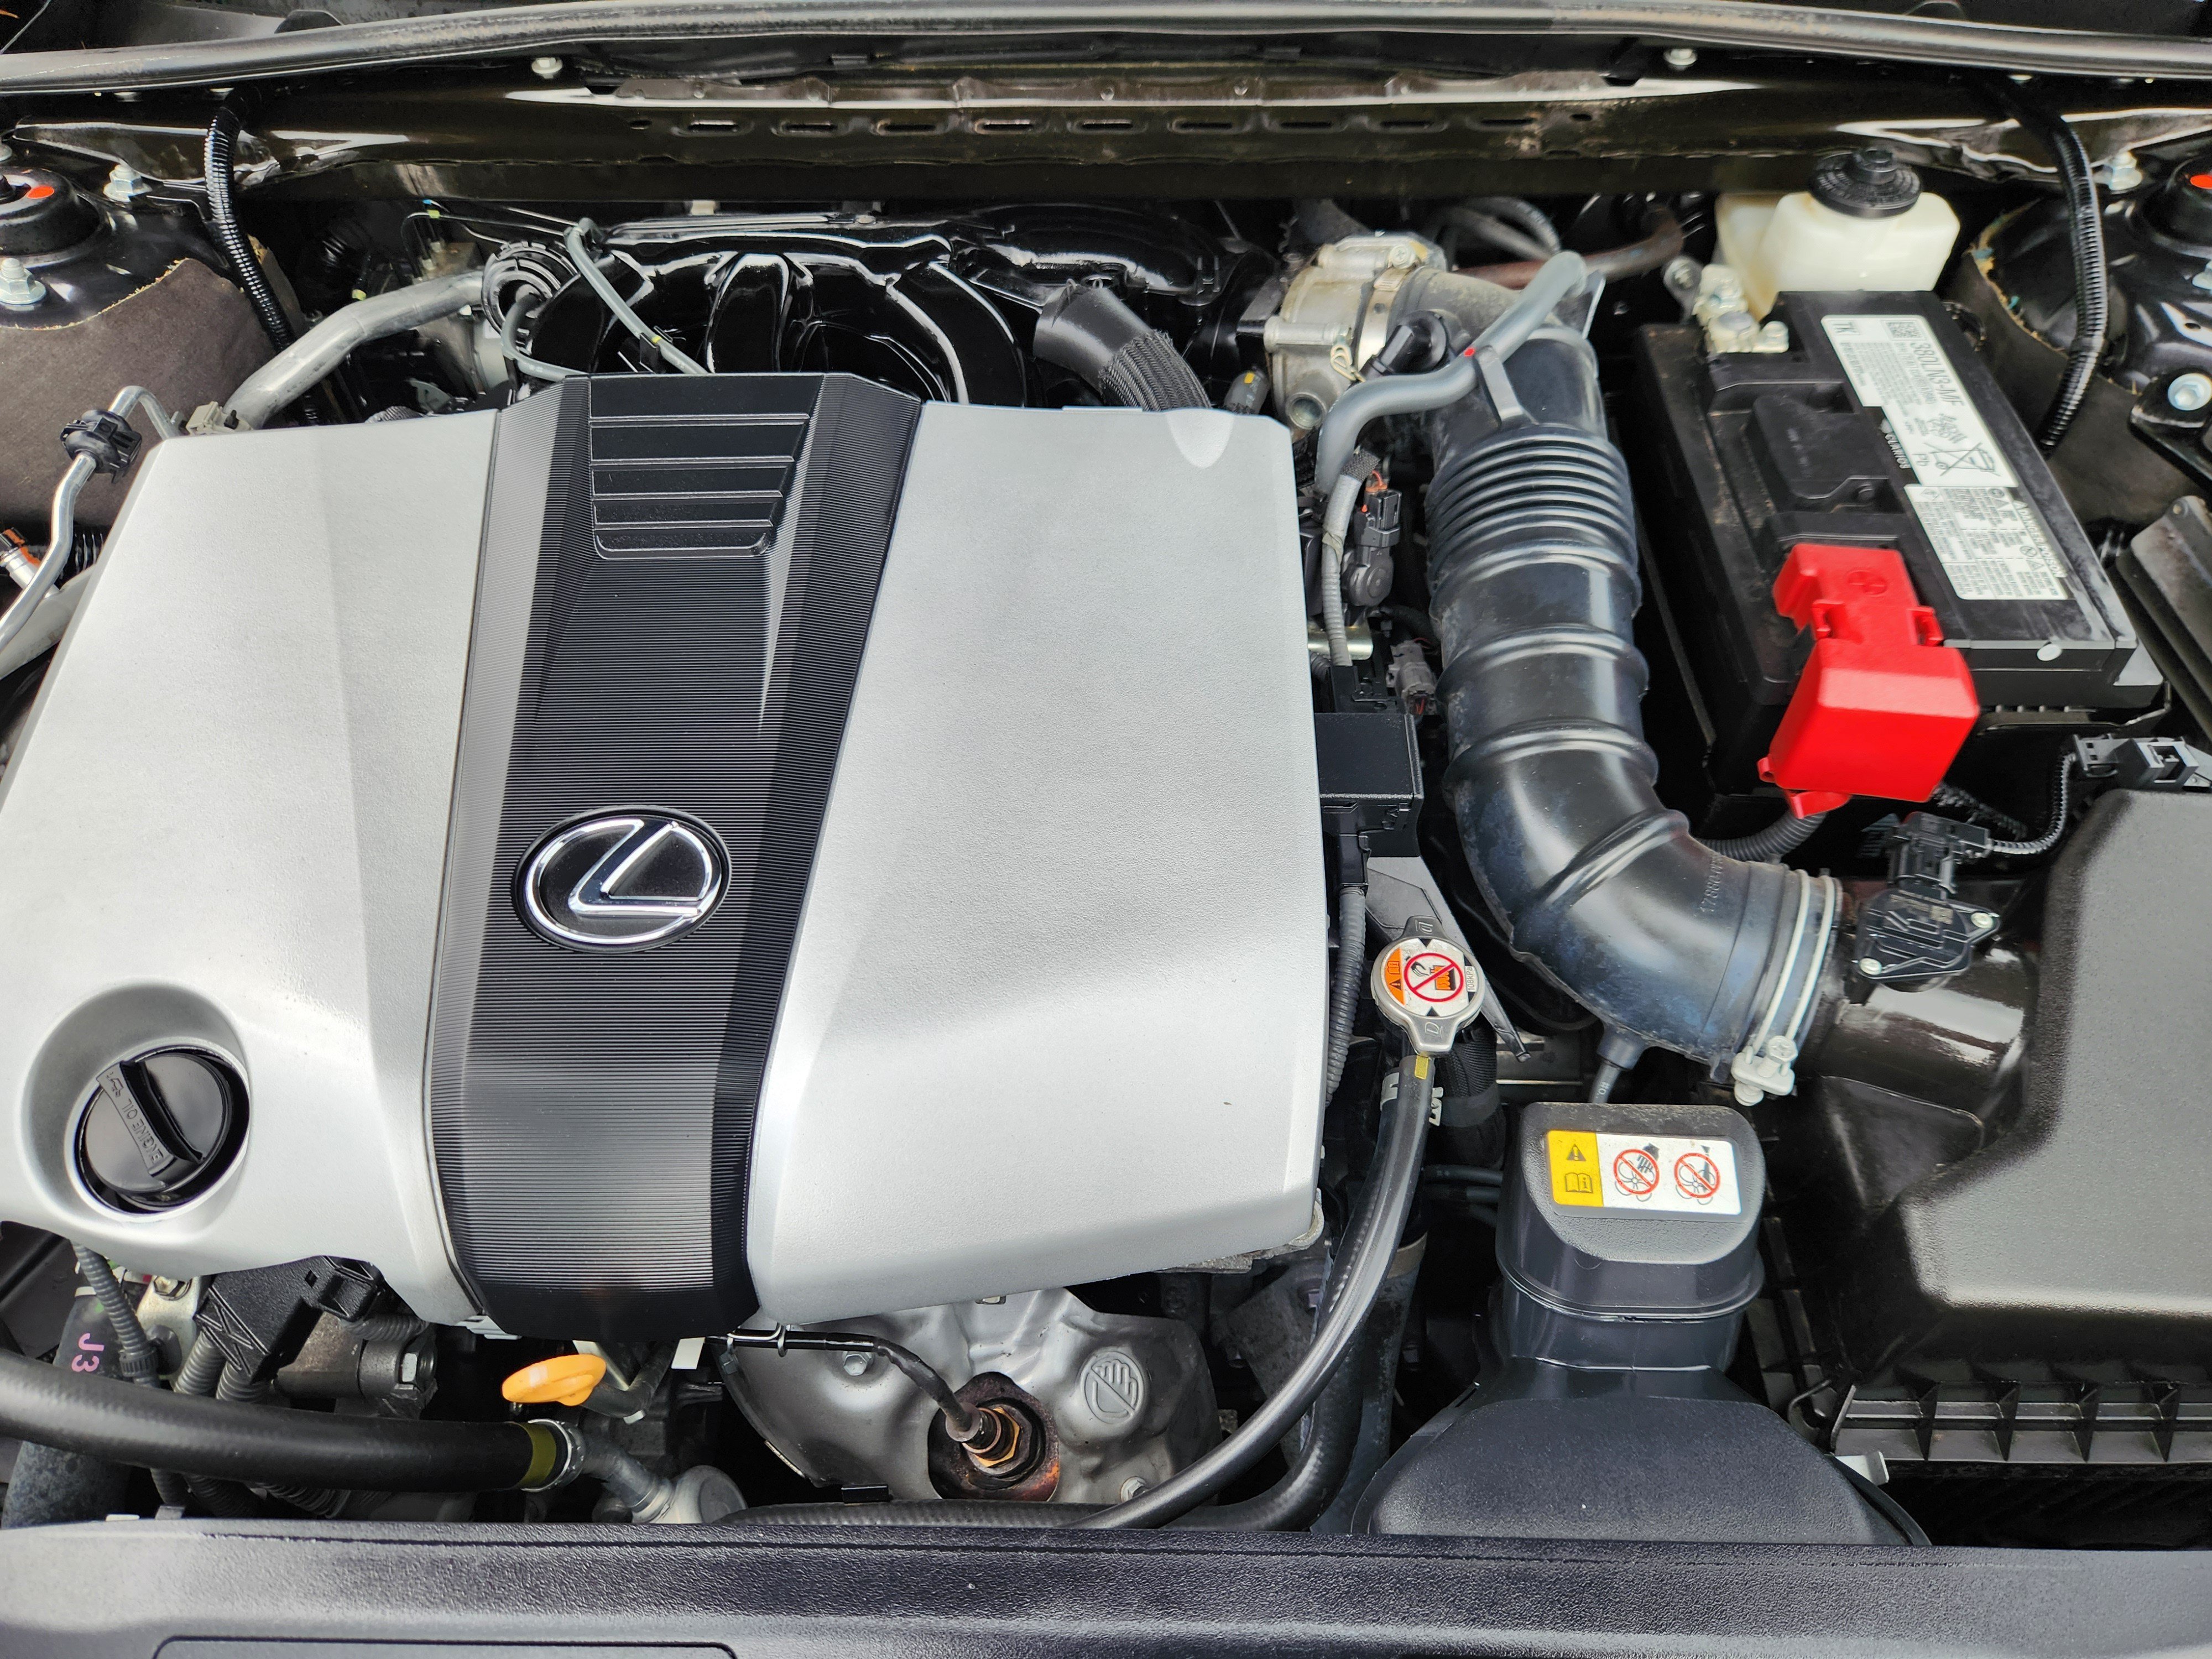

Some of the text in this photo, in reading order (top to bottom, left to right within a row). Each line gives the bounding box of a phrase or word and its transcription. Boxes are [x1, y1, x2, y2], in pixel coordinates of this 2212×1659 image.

[1910, 342, 1964, 406] 380LN3-MF
[1912, 452, 1930, 467] Pb
[1465, 966, 1475, 991] 108kPa
[122, 1098, 164, 1164] ENGINE OIL
[71, 1332, 105, 1373] J3
